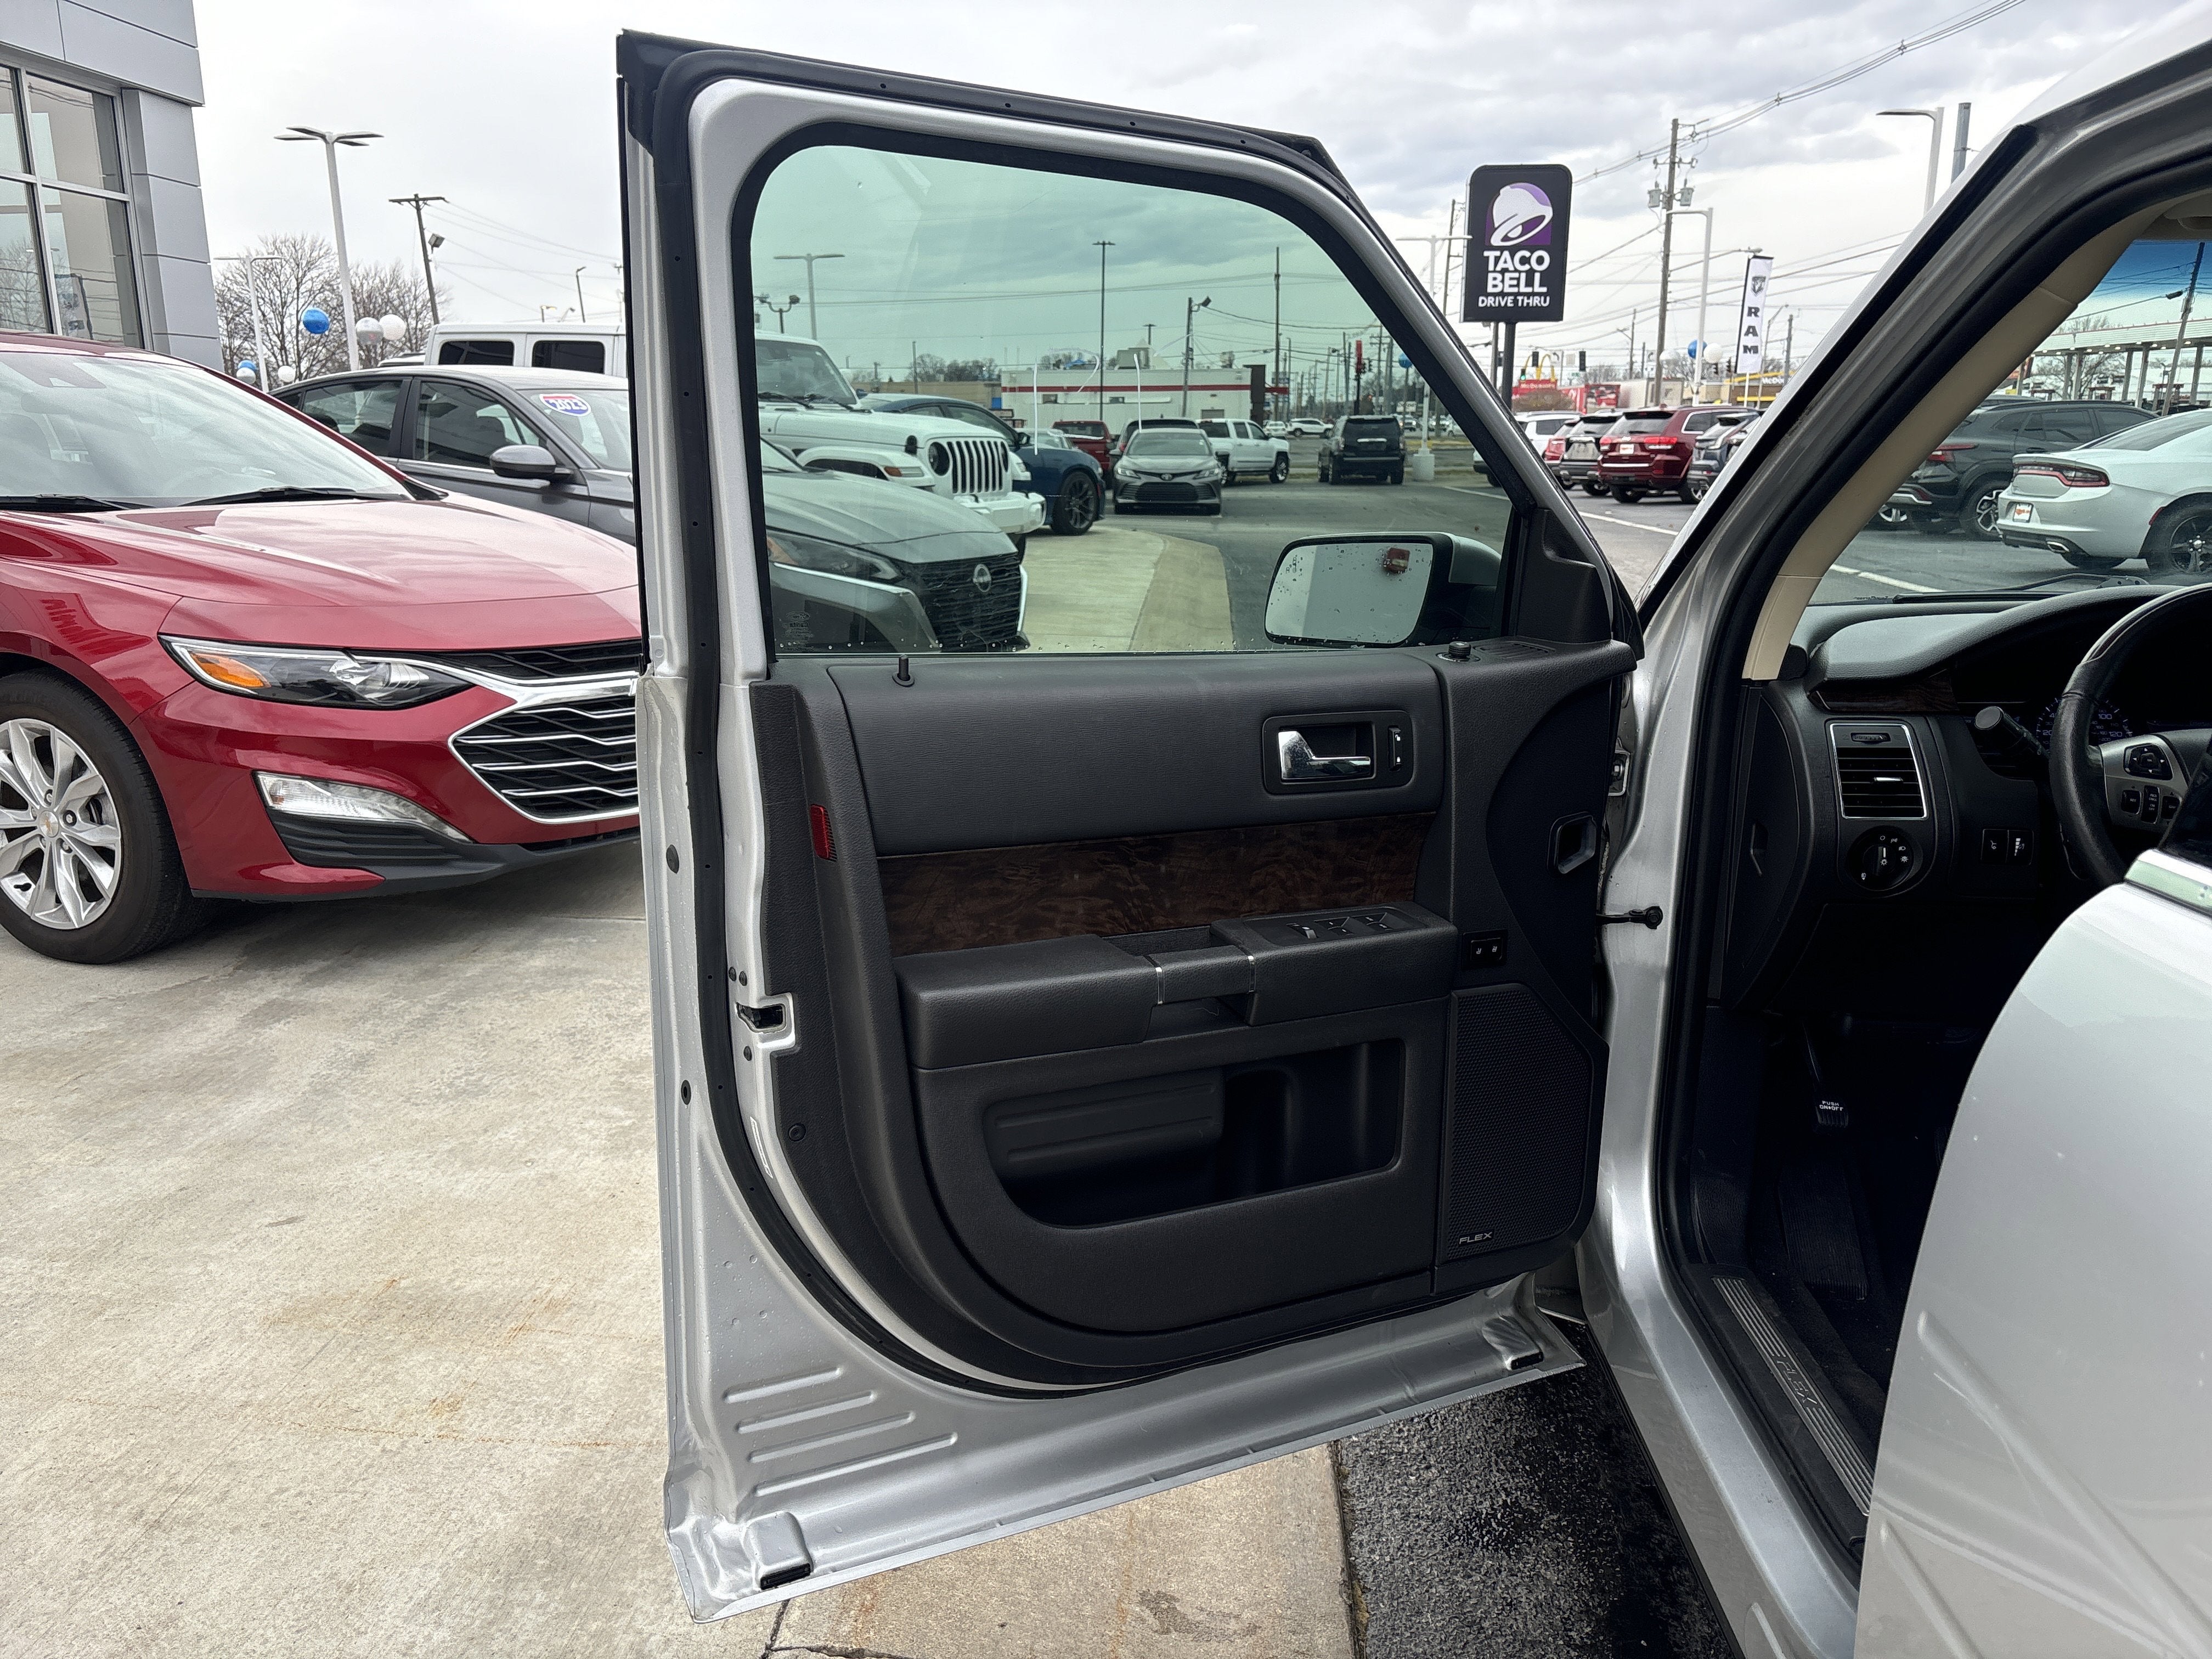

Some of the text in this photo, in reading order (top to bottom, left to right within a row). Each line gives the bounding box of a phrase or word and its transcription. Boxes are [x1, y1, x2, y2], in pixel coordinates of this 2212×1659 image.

[1483, 250, 1550, 271] TACO
[1487, 272, 1548, 293] BELL
[1478, 296, 1550, 307] DRIVE THRU
[1742, 306, 1760, 354] RAM
[1459, 1231, 1492, 1244] FLEX
[1776, 1361, 1818, 1405] FLEX
